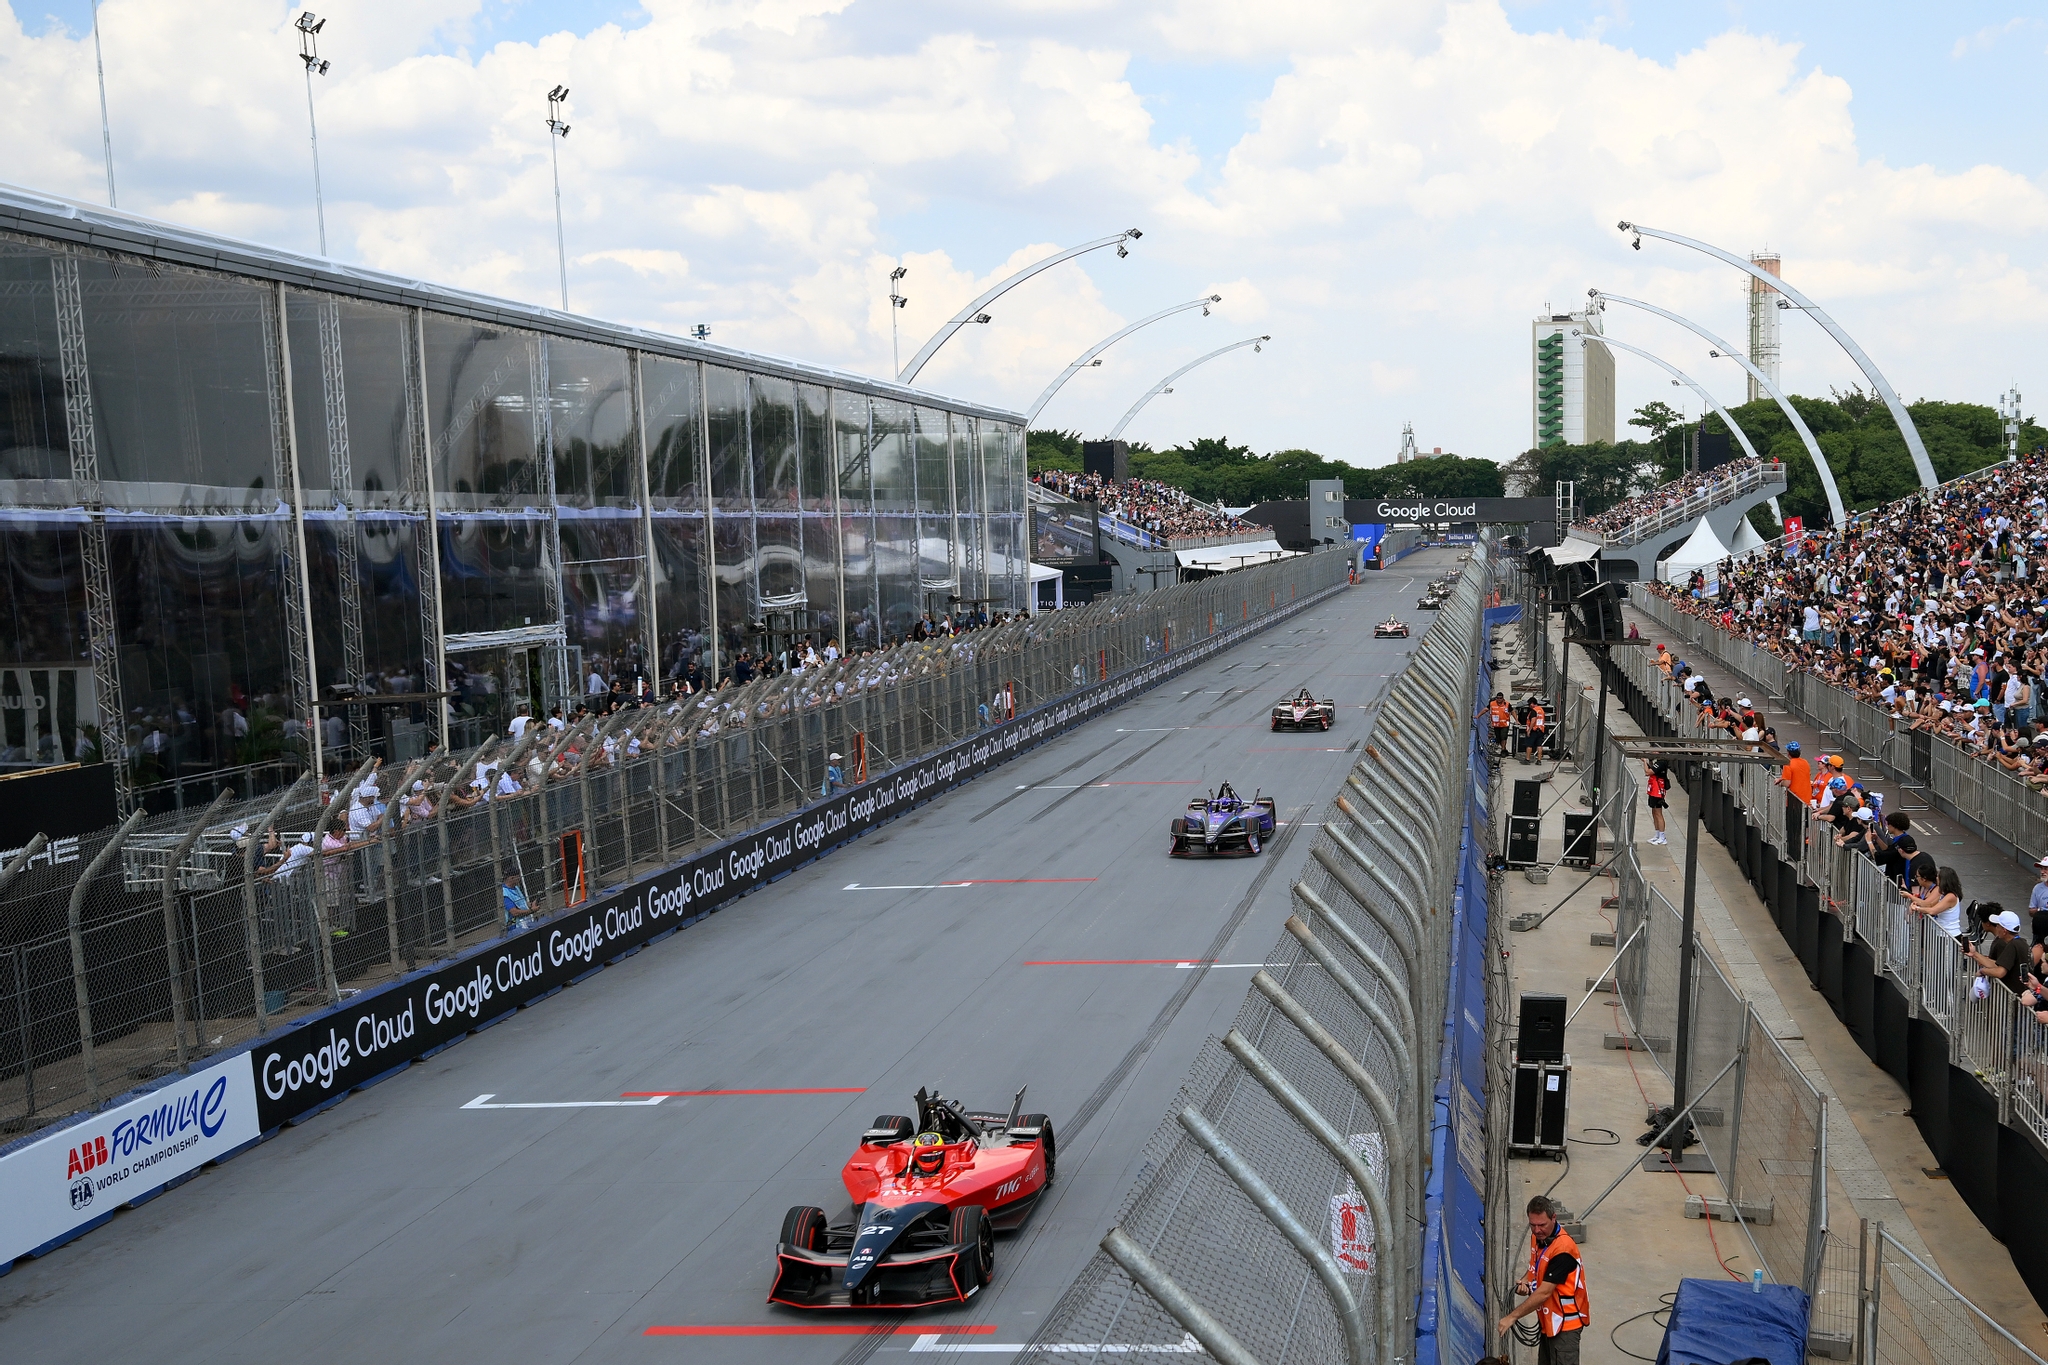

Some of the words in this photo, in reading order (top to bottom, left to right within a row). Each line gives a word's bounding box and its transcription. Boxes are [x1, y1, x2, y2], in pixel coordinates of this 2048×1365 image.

[1377, 502, 1430, 520] Google
[1434, 502, 1476, 516] Cloud
[971, 739, 989, 765] Google
[989, 735, 1002, 756] Cloud
[1003, 726, 1019, 751] Google
[1018, 722, 1031, 742] Cloud
[896, 771, 918, 800] Google
[918, 764, 935, 789] Cloud
[936, 754, 956, 781] Google
[956, 749, 971, 770] Cloud
[849, 790, 875, 822] Google
[875, 782, 895, 809] Cloud
[795, 814, 825, 849] Google
[825, 803, 847, 834] Cloud
[729, 841, 764, 881] Google
[765, 829, 791, 864] Cloud
[648, 874, 691, 920] Google
[693, 858, 725, 898] Cloud
[549, 915, 603, 967] Google
[605, 896, 643, 940] Cloud
[425, 965, 493, 1025] Google
[495, 940, 543, 992] Cloud
[262, 1027, 351, 1101] Google
[355, 997, 415, 1058] Cloud
[67, 1135, 109, 1180] ABB
[111, 1089, 199, 1165] FORMULA
[96, 1167, 130, 1191] WORLD
[132, 1134, 199, 1174] CHAMPIONSHIP
[880, 1189, 923, 1197] TWG
[995, 1175, 1022, 1200] TWG
[861, 1226, 894, 1235] 27
